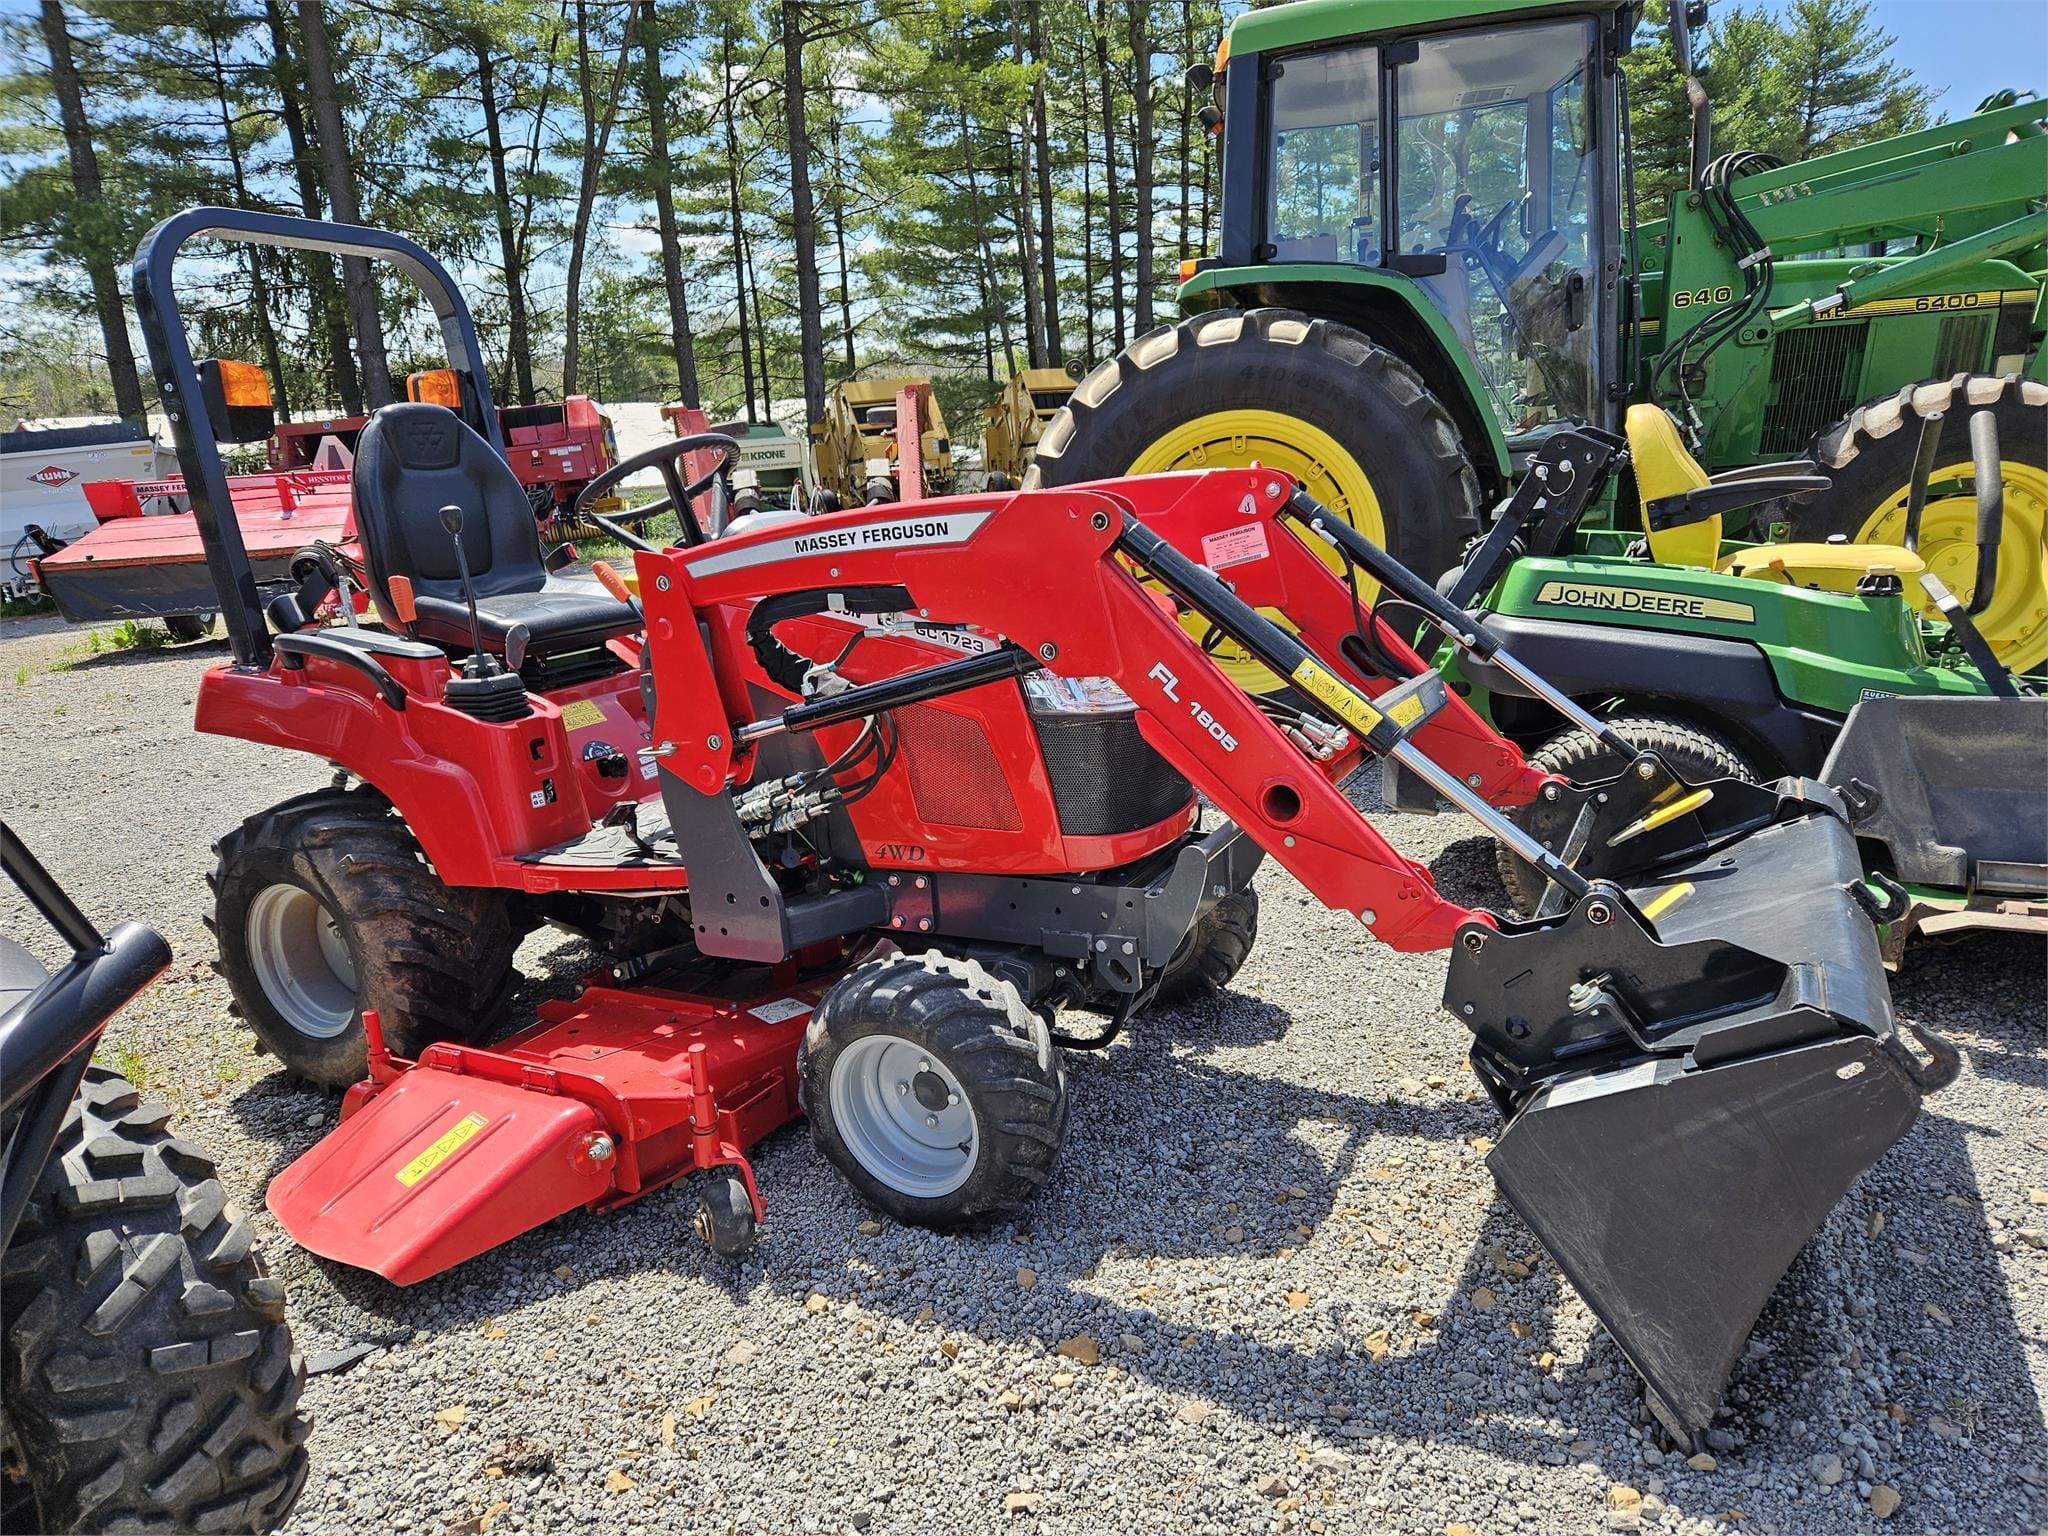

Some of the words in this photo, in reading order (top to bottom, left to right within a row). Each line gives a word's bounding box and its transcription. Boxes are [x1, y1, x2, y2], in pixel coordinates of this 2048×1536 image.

[1673, 285, 1732, 308] 640
[1915, 293, 1979, 311] 6400
[750, 450, 786, 460] KRONE
[36, 470, 71, 482] KUHN
[136, 485, 169, 493] MASSEY
[794, 532, 857, 553] MASSEY
[862, 522, 949, 544] FERGUSON
[1209, 534, 1229, 542] MASSEY
[1229, 526, 1256, 537] FERGUSON
[1550, 586, 1615, 609] JOHN
[1622, 591, 1705, 616] DEERE
[941, 629, 985, 653] 1723
[1147, 661, 1180, 704] FL
[1190, 701, 1239, 753] 1805
[874, 842, 925, 861] 4WD
